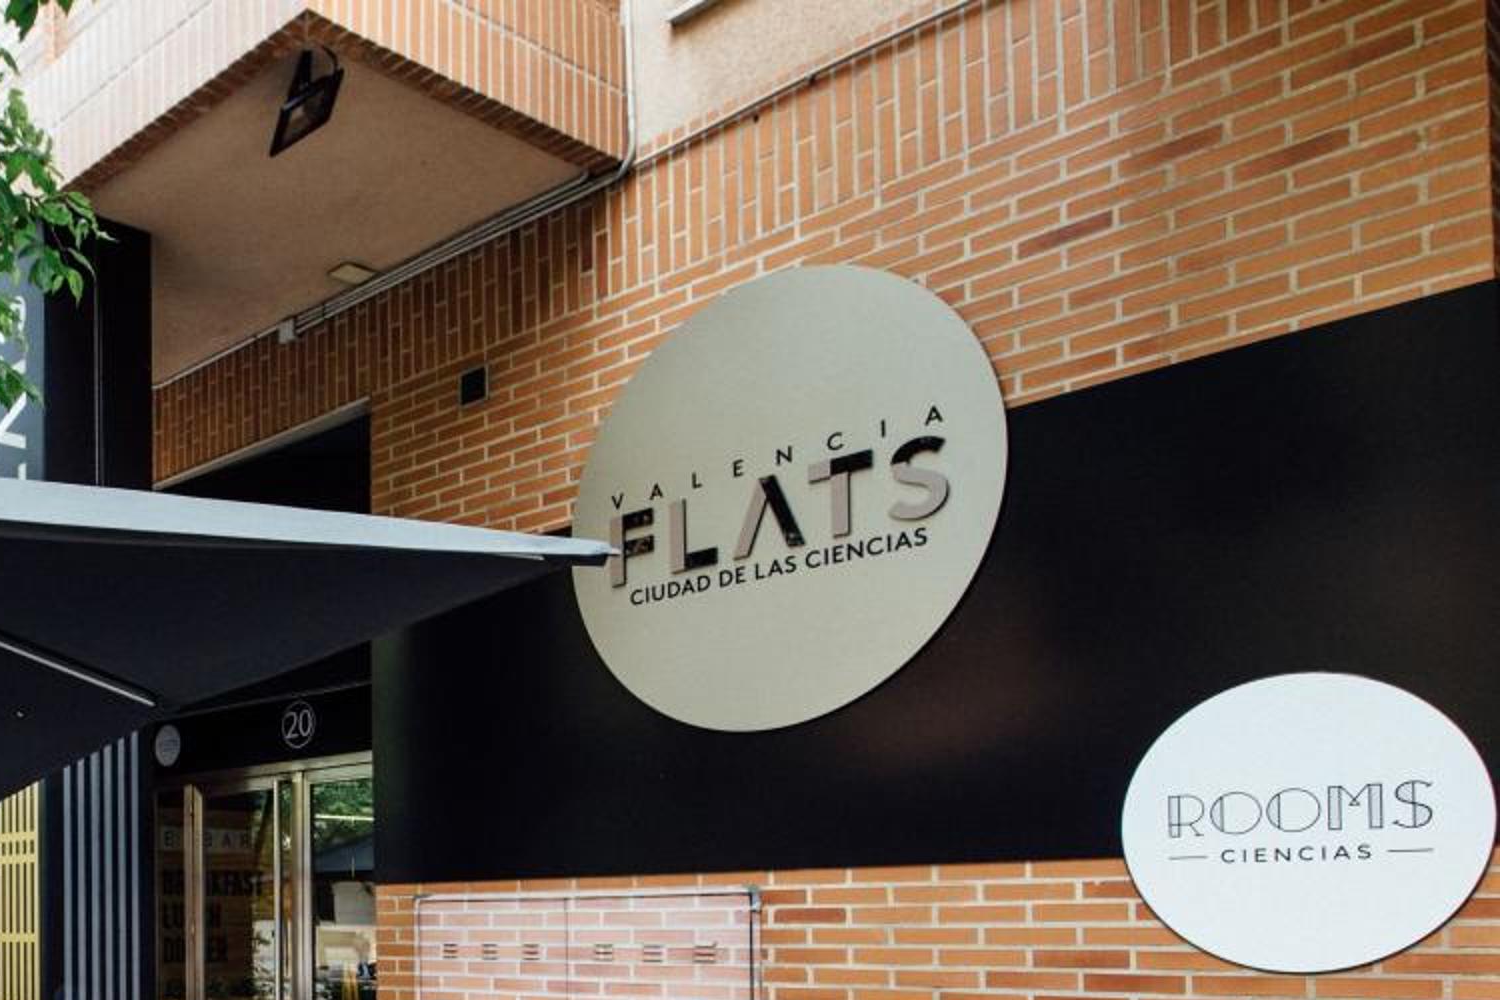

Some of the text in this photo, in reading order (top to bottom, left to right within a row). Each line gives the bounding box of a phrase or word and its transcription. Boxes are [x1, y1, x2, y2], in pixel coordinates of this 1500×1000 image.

[612, 404, 943, 510] VALENCIA
[609, 435, 950, 588] FLATS
[629, 527, 929, 606] CIUDAD DE LAS CIENCIAS
[284, 708, 313, 740] 20
[1167, 779, 1434, 838] ROOMS
[1220, 844, 1373, 864] CIENCIAS
